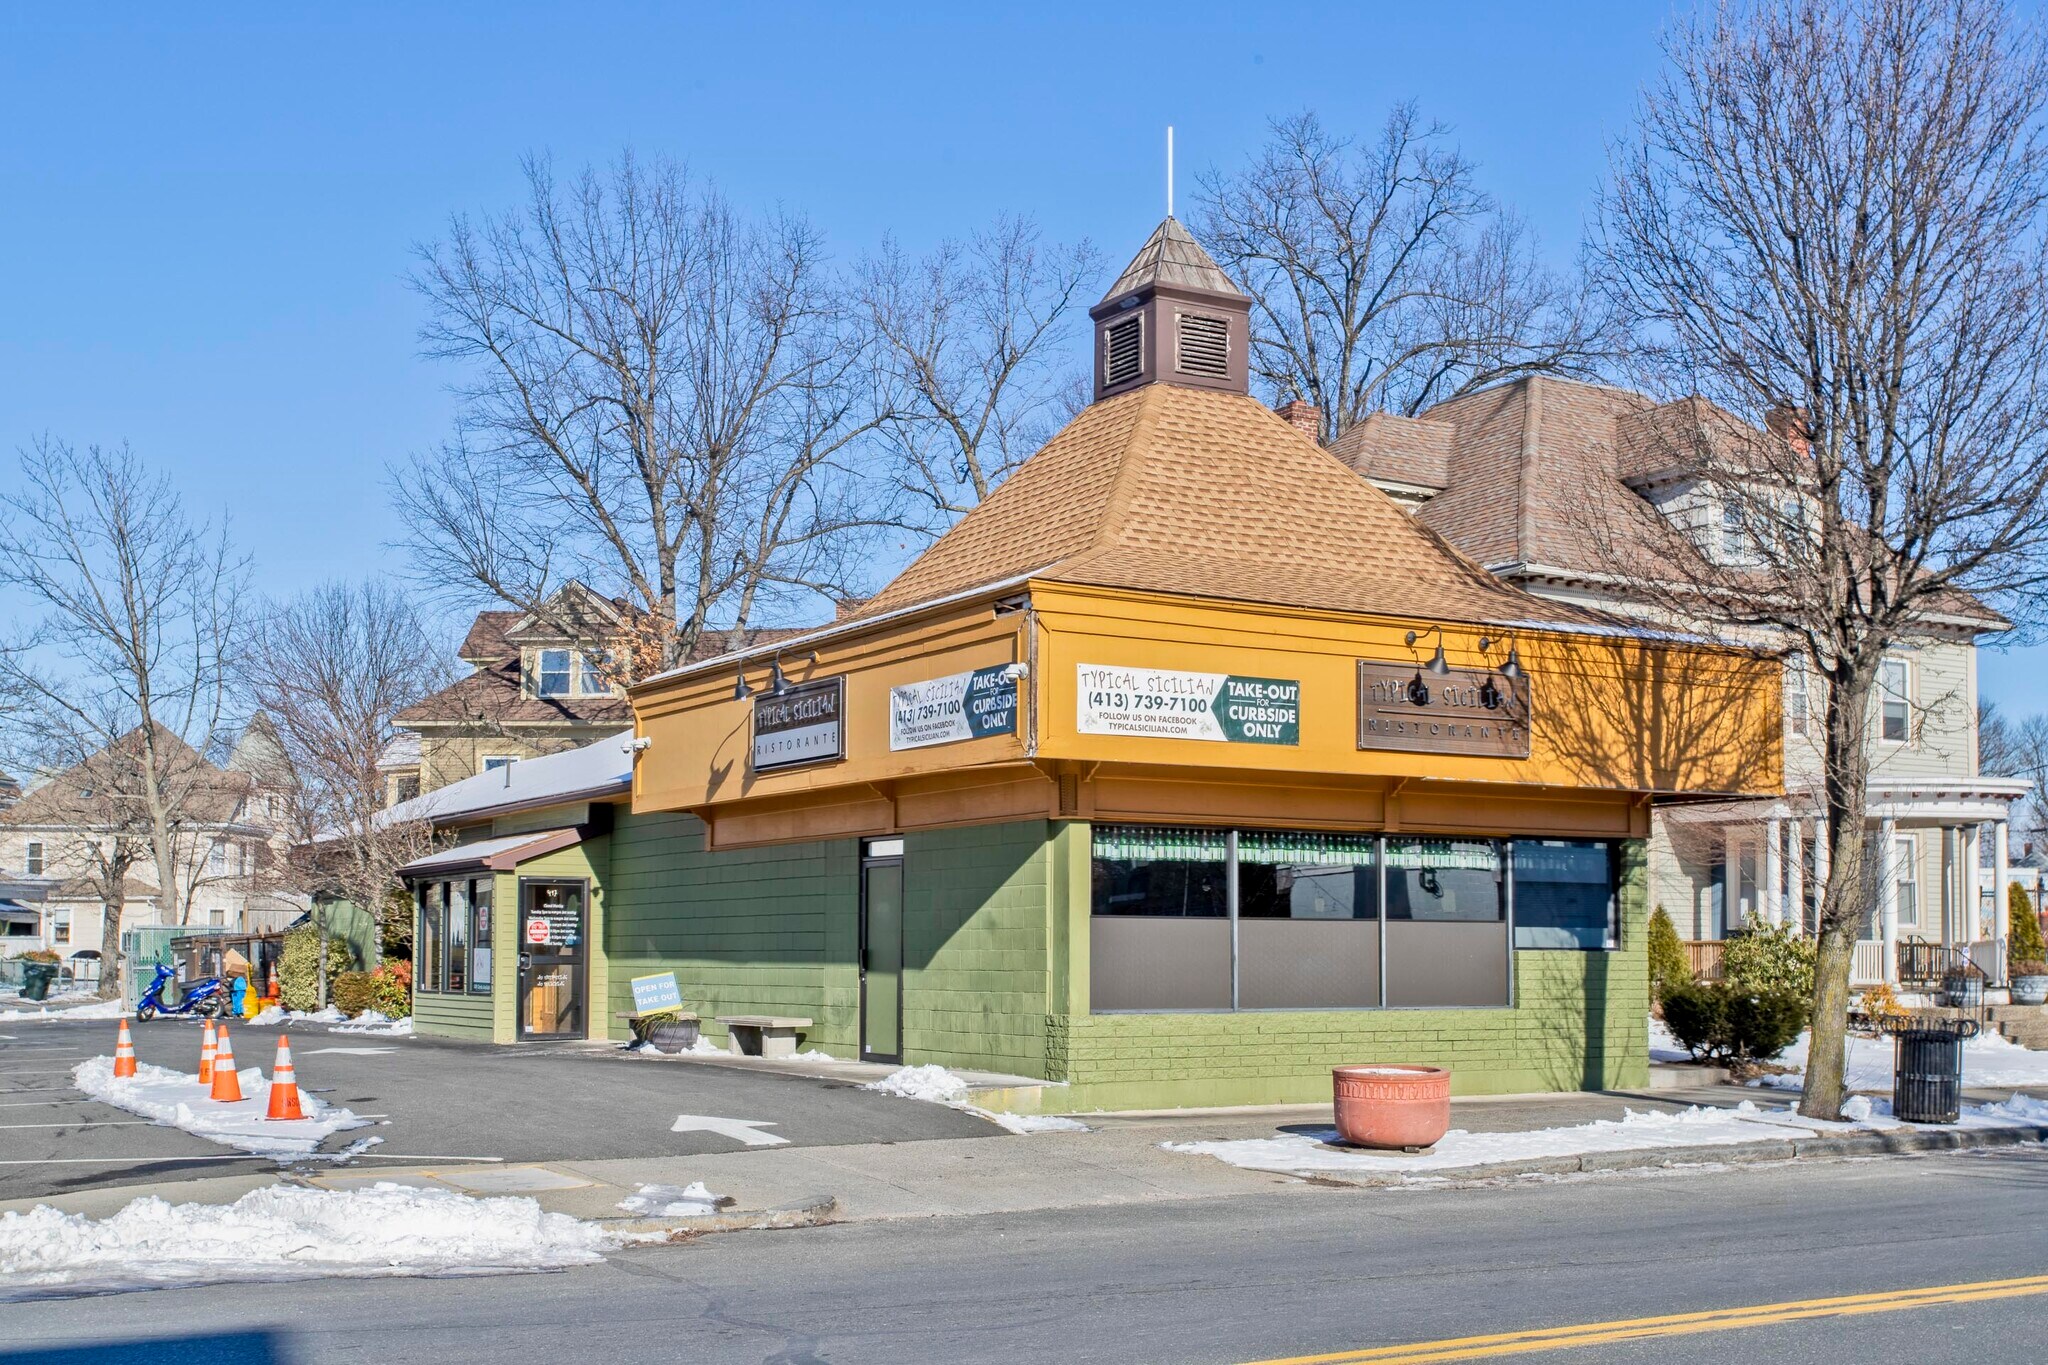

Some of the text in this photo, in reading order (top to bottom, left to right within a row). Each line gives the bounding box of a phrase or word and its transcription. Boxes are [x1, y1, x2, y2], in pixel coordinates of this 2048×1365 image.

[926, 678, 967, 702] SICILIAN
[1081, 669, 1215, 696] TYPICAL SICILIAN
[1227, 681, 1298, 701] TAKE-OUT
[973, 693, 1017, 715] CURBSIDE
[1088, 691, 1208, 714] (413) 739-7100
[1256, 698, 1270, 707] FOR
[1442, 684, 1518, 709] SICILIAN
[757, 692, 837, 729] TYPICAL SICILIAN
[895, 699, 961, 728] (413) 739-7100
[982, 711, 1009, 730] ONLY
[1099, 712, 1131, 721] FOLLOW
[1132, 714, 1142, 722] US
[1158, 715, 1198, 725] FACEBOOK
[1228, 705, 1296, 724] CURBSIDE
[1108, 722, 1188, 734] TYPICALSICILIAN.COM
[1243, 722, 1283, 738] ONLY
[1367, 717, 1521, 741] RISTORANTE
[756, 731, 837, 756] RISTORANTE
[634, 981, 675, 994] OPEN FOR
[637, 991, 678, 1006] TAKE OUT
